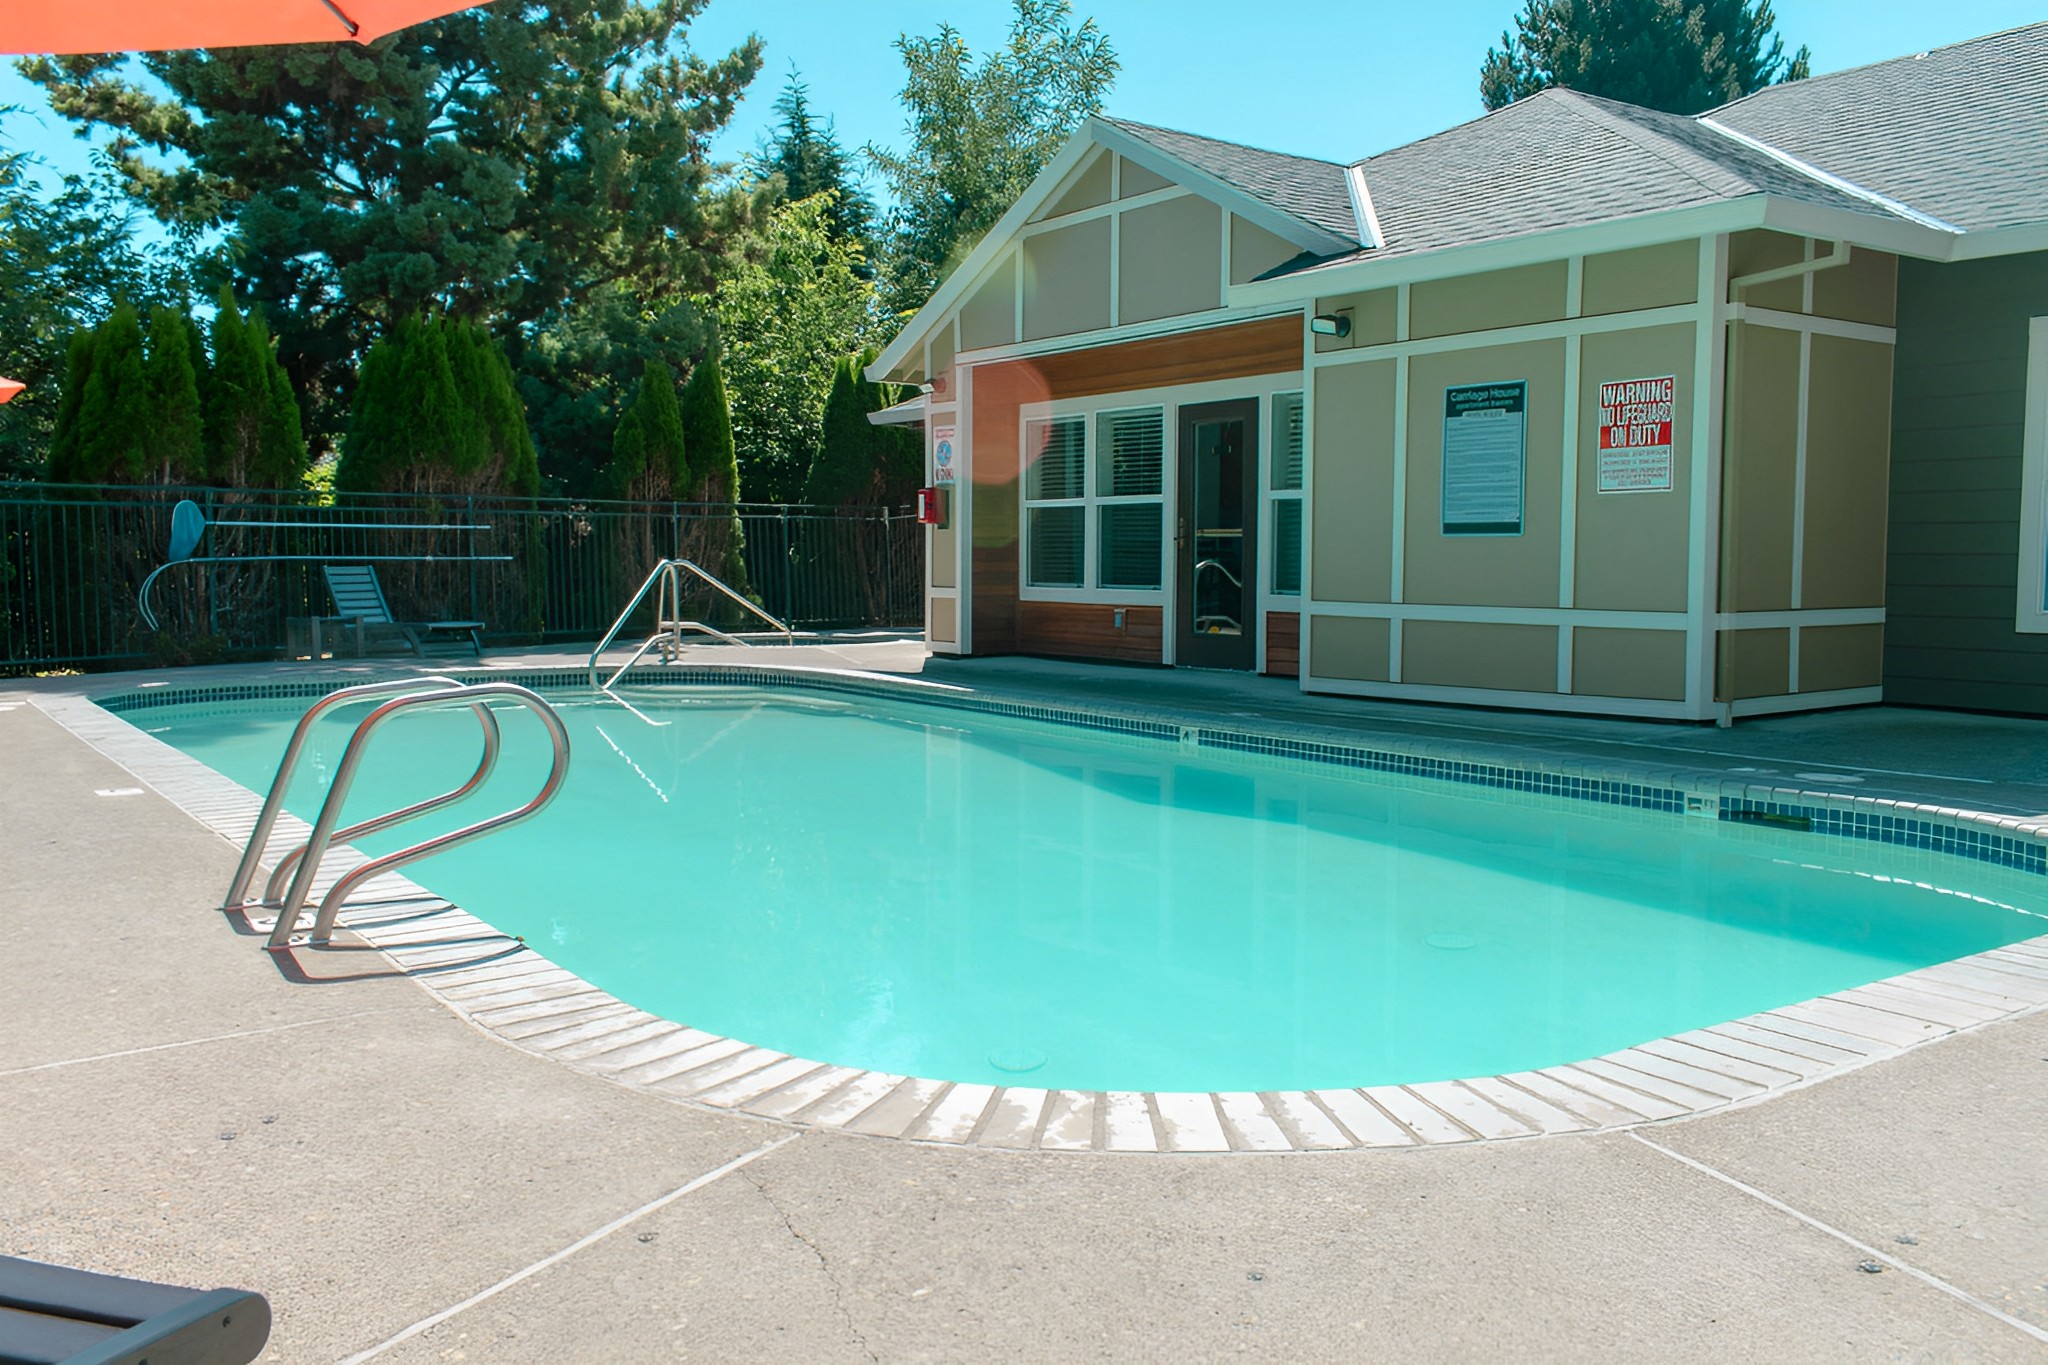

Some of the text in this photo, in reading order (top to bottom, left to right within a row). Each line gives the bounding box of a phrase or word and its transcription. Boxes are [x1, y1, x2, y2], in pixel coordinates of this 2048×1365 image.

[1490, 388, 1520, 398] House
[1603, 380, 1671, 406] WARNING
[1611, 423, 1660, 447] ON DUTY
